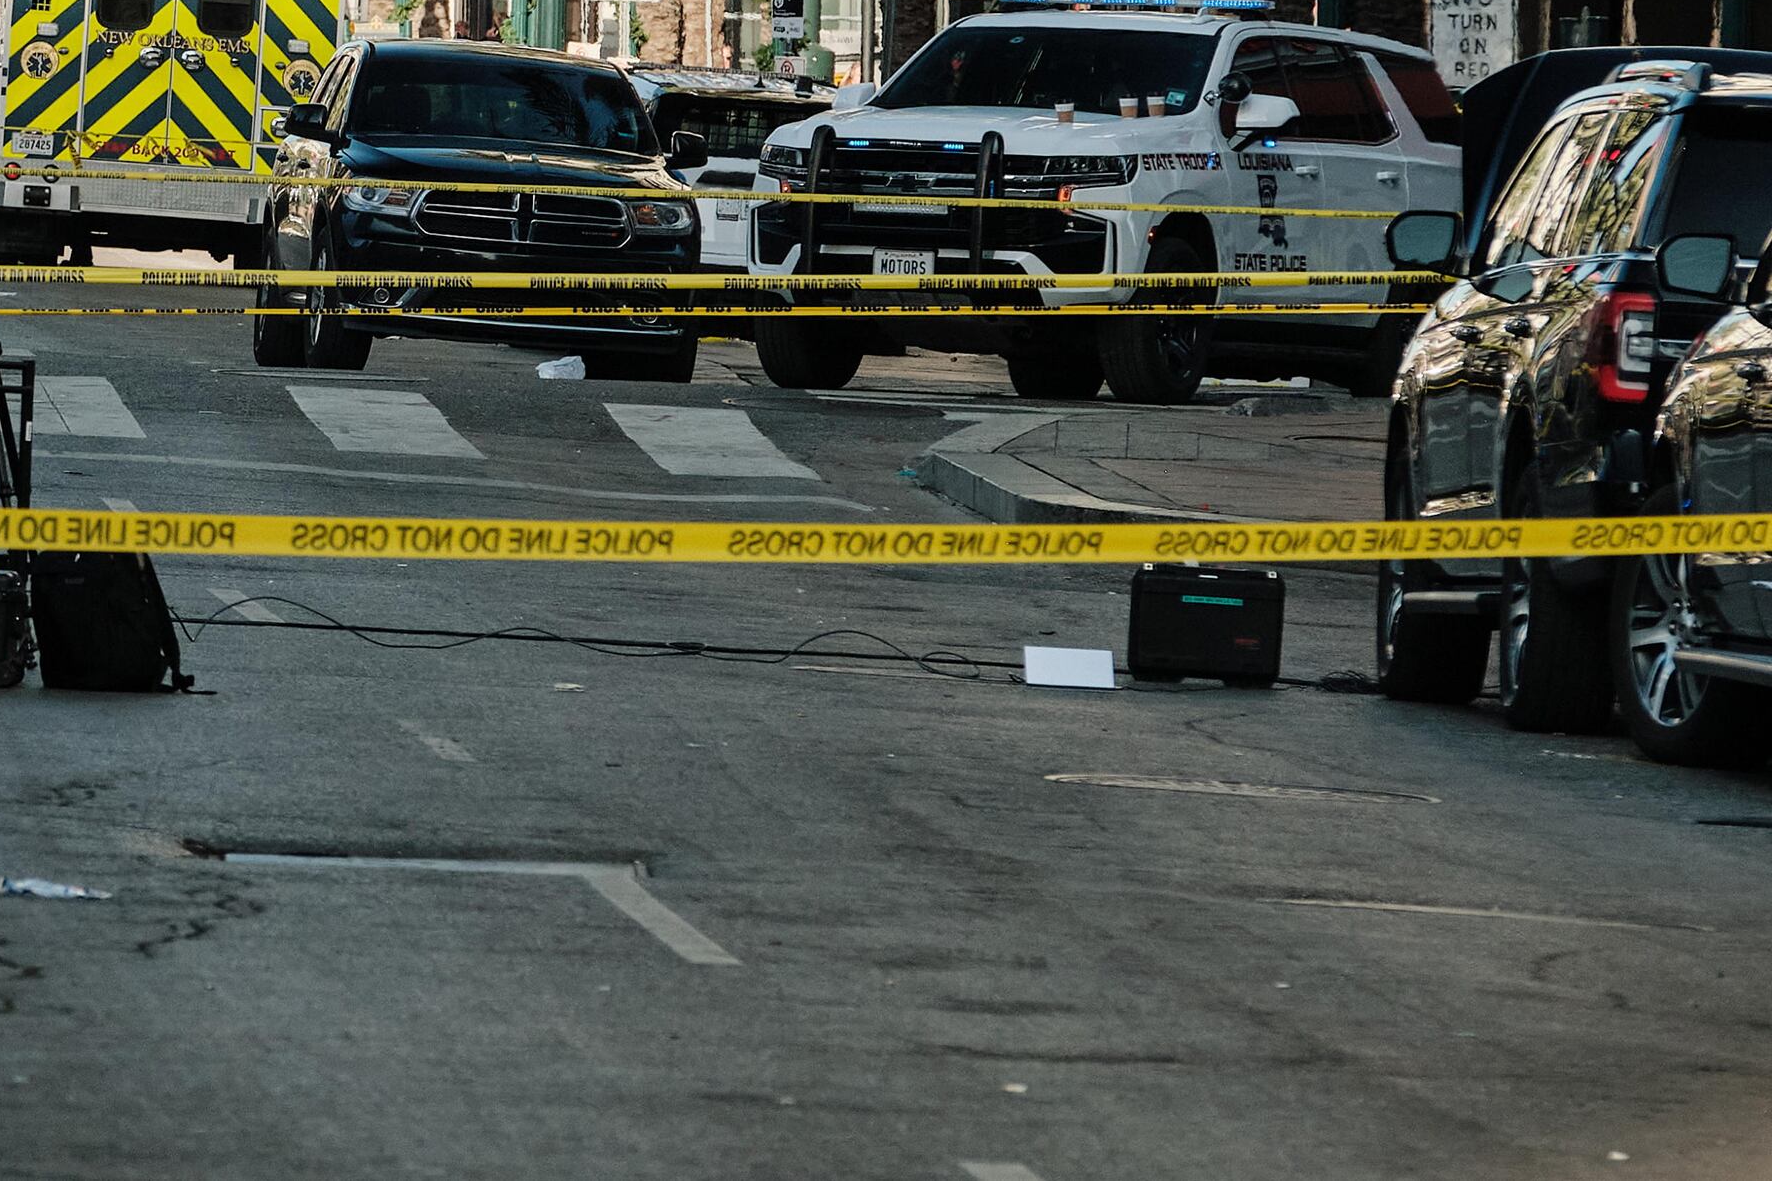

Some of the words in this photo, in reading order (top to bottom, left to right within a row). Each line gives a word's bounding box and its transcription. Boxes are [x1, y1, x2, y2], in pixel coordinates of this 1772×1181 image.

[1447, 13, 1498, 30] TURN
[96, 29, 136, 47] NEW
[138, 33, 214, 51] ORLEANS
[218, 37, 251, 54] EMS
[1459, 38, 1487, 55] ON
[1454, 61, 1490, 78] RED
[132, 144, 169, 157] BACK
[1142, 154, 1176, 171] STATE
[1237, 154, 1294, 172] LOUISIANA
[880, 259, 926, 275] MOTORS
[1234, 253, 1267, 270] STATE
[1270, 255, 1307, 272] POLICE
[9, 269, 23, 283] DO
[27, 269, 46, 283] NOT
[48, 269, 85, 284] CROSS
[142, 271, 178, 285] POLICE
[179, 272, 202, 286] LINE
[204, 272, 218, 286] DO
[220, 273, 242, 286] NOT
[243, 273, 279, 287] CROSS
[336, 275, 373, 288] POLICE
[373, 275, 395, 288] LINE
[398, 276, 413, 289] DO
[416, 276, 436, 289] NOT
[437, 276, 473, 289] CROSS
[530, 278, 566, 289] POLICE
[568, 278, 590, 289] LINE
[592, 278, 607, 289] DO
[609, 278, 629, 289] NOT
[631, 278, 667, 289] CROSS
[724, 278, 760, 289] POLICE
[762, 278, 784, 289] LINE
[787, 278, 801, 289] DO
[803, 278, 824, 289] NOT
[825, 278, 862, 290] CROSS
[919, 278, 955, 289] POLICE
[957, 278, 979, 289] LINE
[982, 278, 995, 289] DO
[997, 278, 1018, 289] NOT
[1020, 278, 1057, 289] CROSS
[1113, 277, 1149, 288] POLICE
[1151, 277, 1173, 288] LINE
[1176, 277, 1189, 288] DO
[1191, 277, 1213, 288] NOT
[1215, 277, 1252, 288] CROSS
[1308, 275, 1344, 286] POLICE
[1347, 275, 1368, 286] LINE
[1370, 275, 1385, 285] DO
[1387, 274, 1409, 284] NOT
[1410, 274, 1446, 284] CROSS
